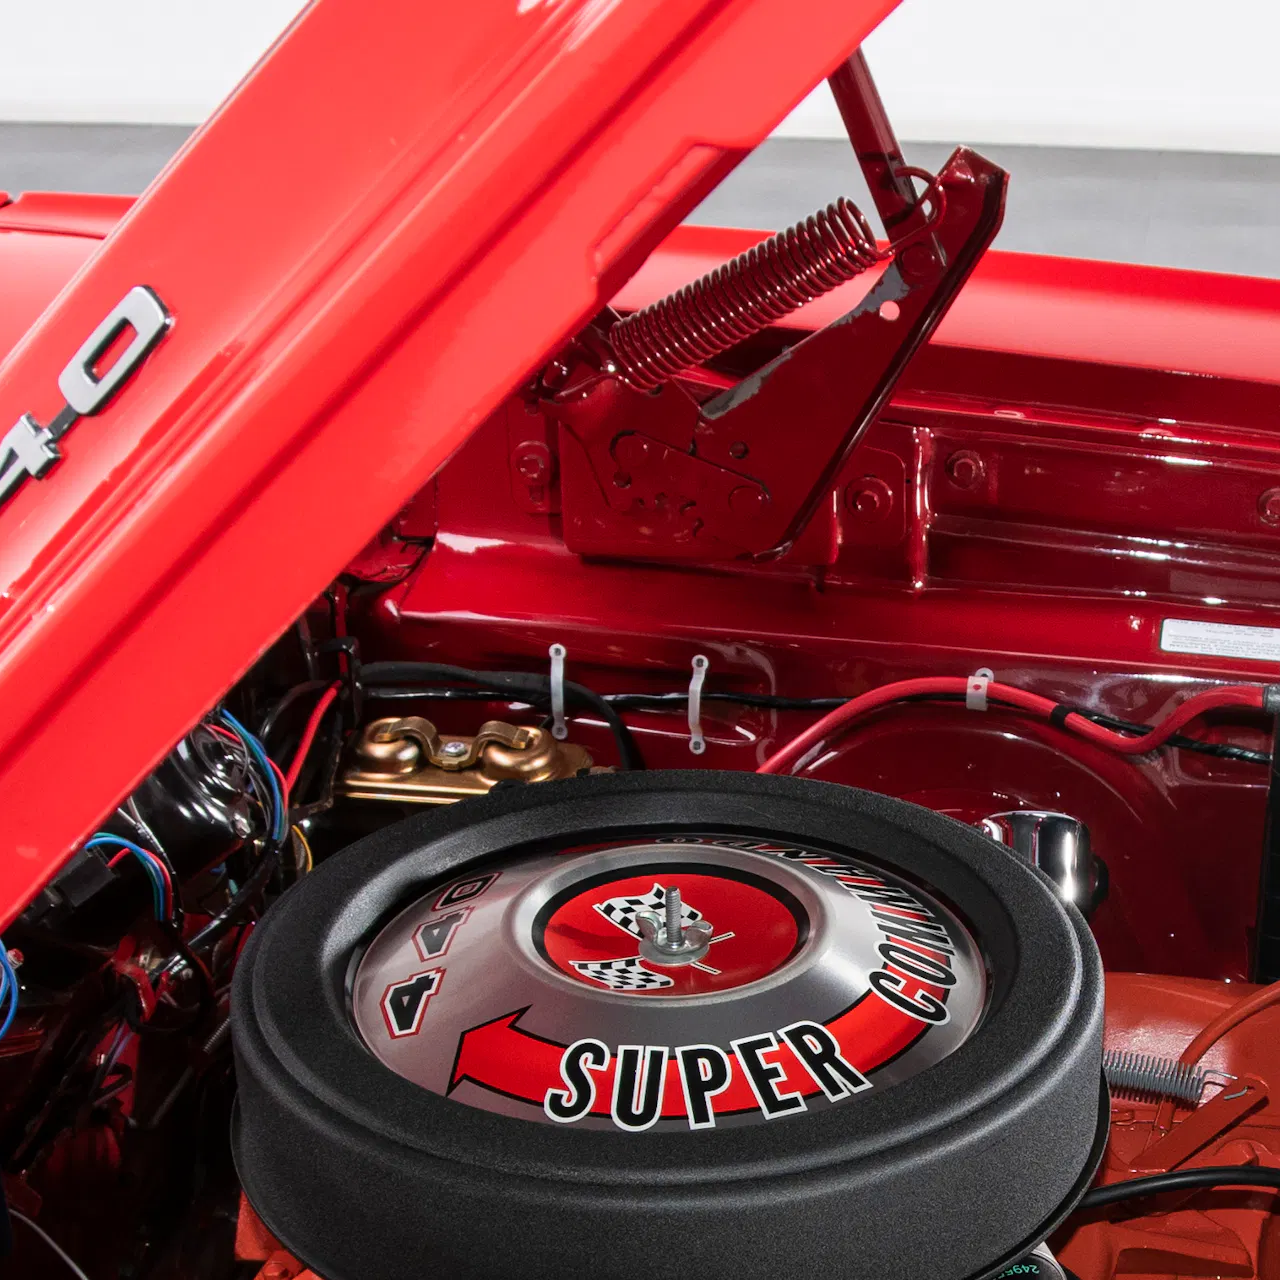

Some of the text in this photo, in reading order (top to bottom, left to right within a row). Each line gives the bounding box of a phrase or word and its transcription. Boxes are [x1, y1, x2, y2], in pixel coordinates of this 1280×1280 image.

[379, 872, 504, 1040] 440
[543, 836, 960, 1132] SUPER COMMANDO
